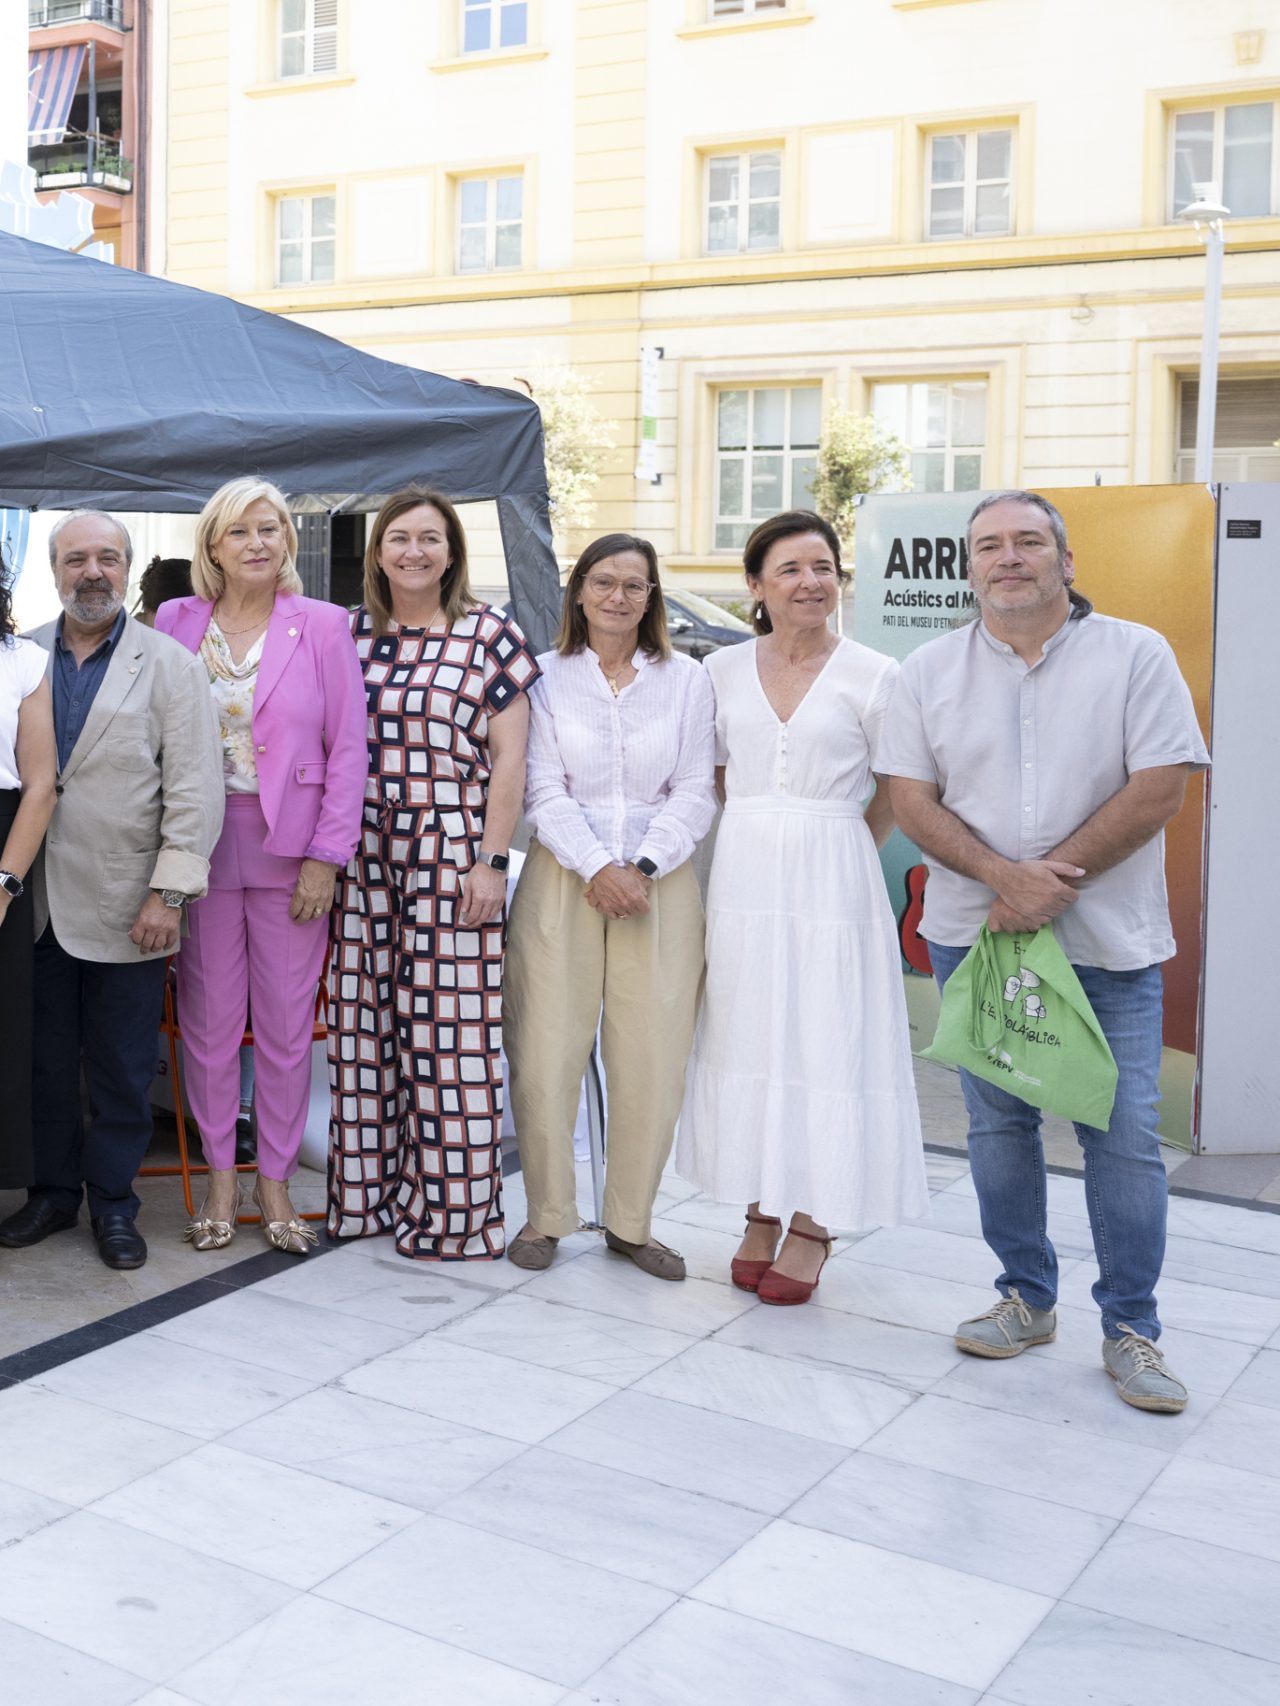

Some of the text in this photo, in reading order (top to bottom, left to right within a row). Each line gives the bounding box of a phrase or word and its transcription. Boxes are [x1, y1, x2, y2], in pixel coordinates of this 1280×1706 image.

[883, 589, 942, 608] Acústics
[945, 591, 959, 608] al
[882, 615, 896, 626] PATI
[897, 616, 909, 627] DEL
[911, 616, 932, 628] MUSEU
